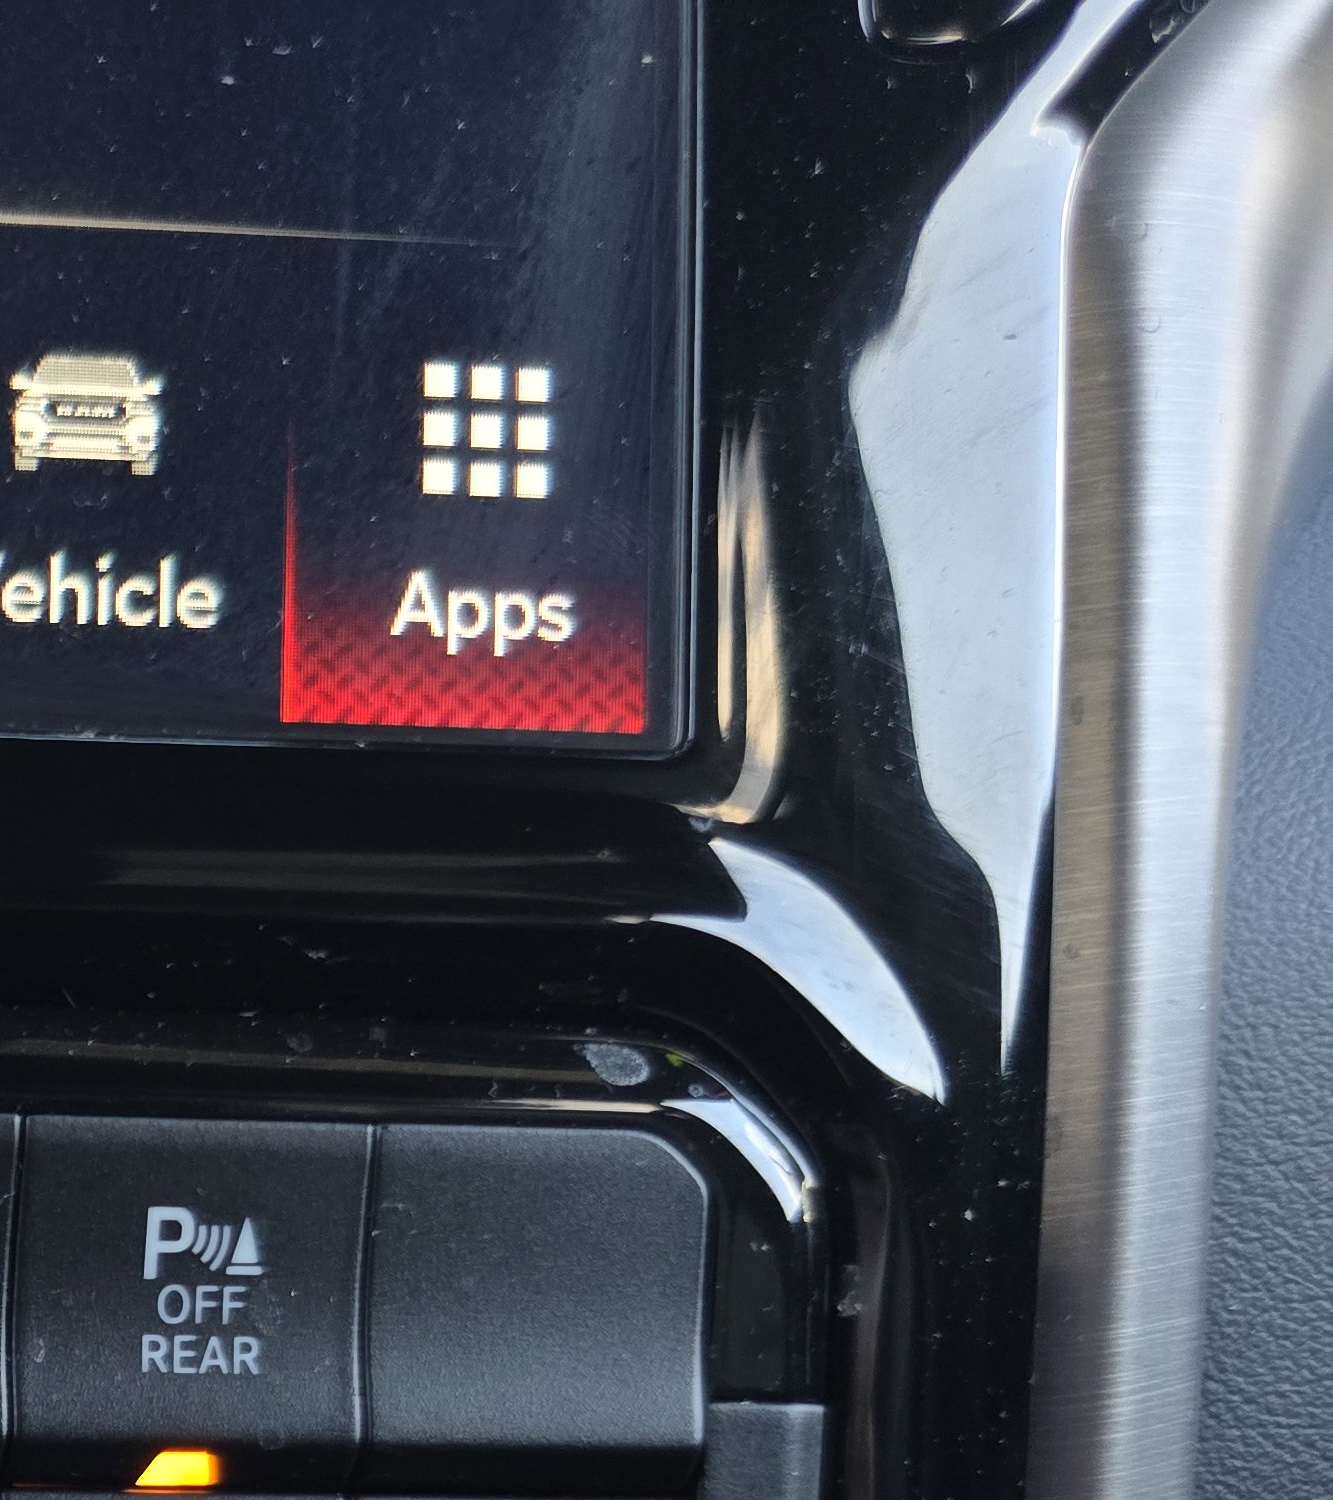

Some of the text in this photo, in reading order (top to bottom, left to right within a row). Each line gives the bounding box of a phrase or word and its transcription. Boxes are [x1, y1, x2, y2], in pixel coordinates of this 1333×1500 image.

[390, 571, 574, 656] Apps
[144, 1207, 193, 1279] P
[158, 1285, 246, 1324] OFF
[142, 1334, 261, 1375] REAR
